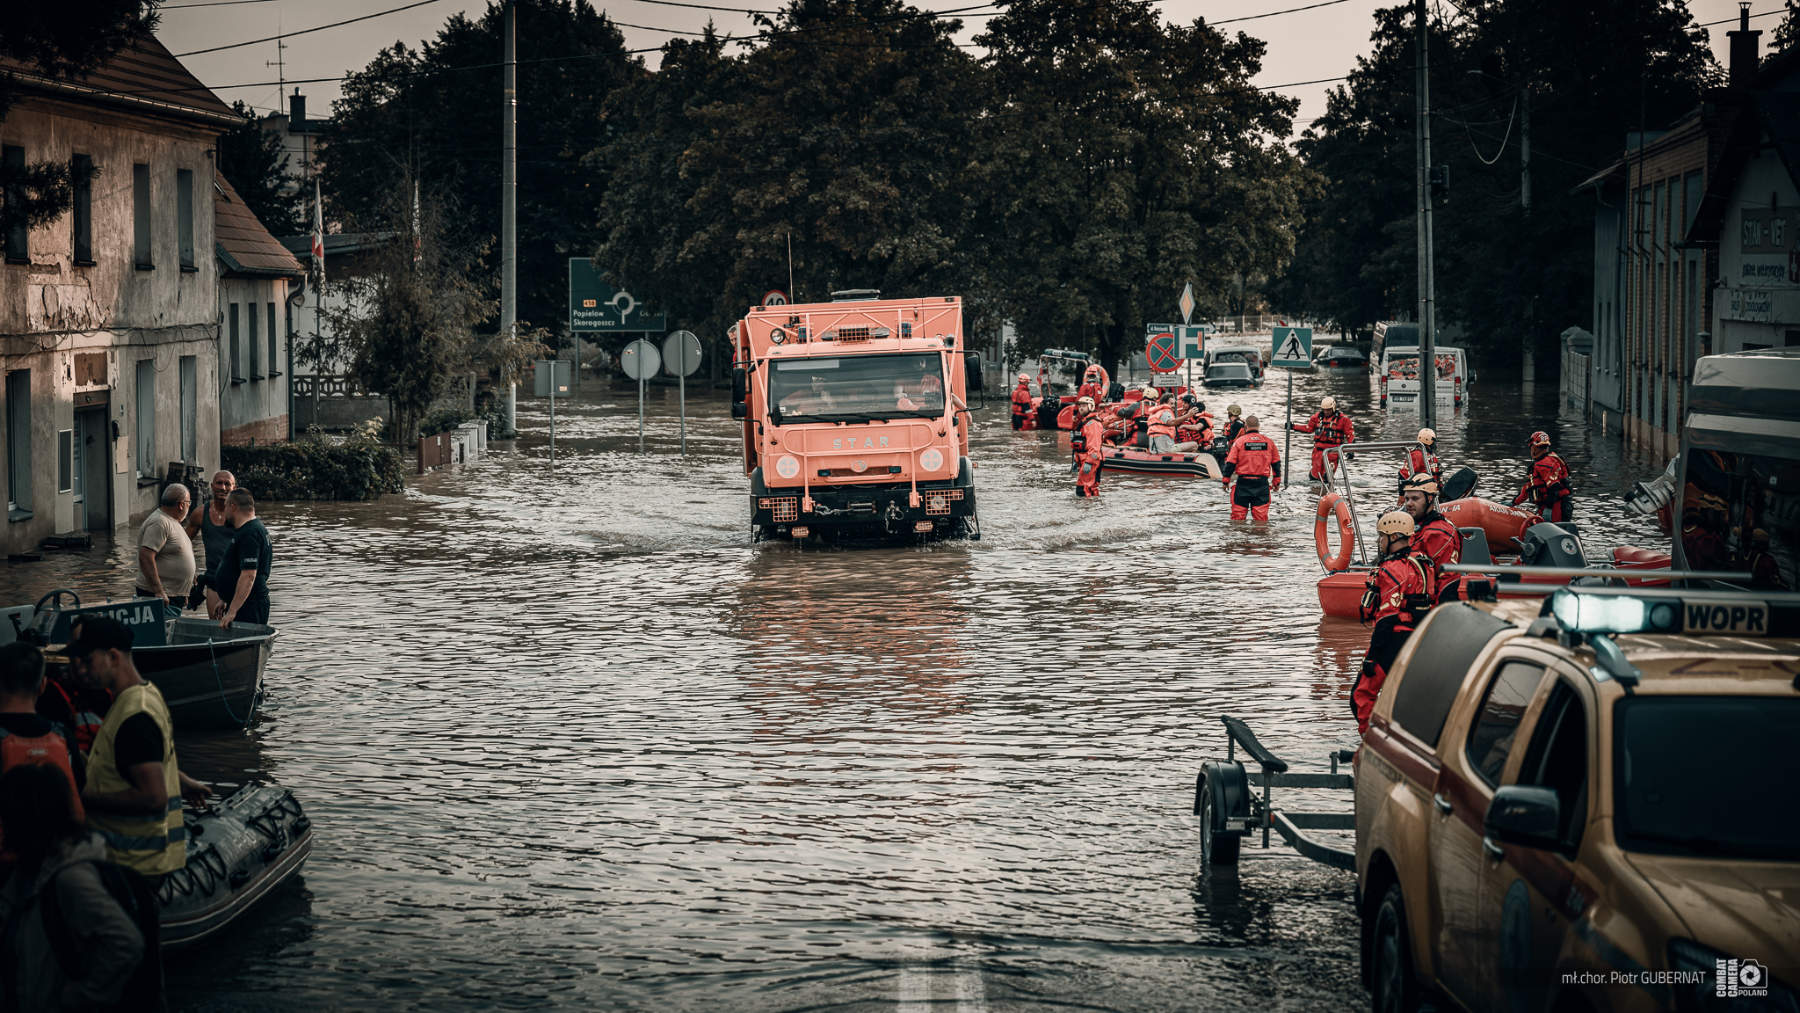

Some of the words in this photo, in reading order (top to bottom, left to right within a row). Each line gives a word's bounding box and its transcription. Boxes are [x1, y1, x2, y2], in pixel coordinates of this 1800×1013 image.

[832, 436, 889, 449] STAR
[71, 606, 155, 625] ICJA
[1688, 605, 1764, 631] WOPR
